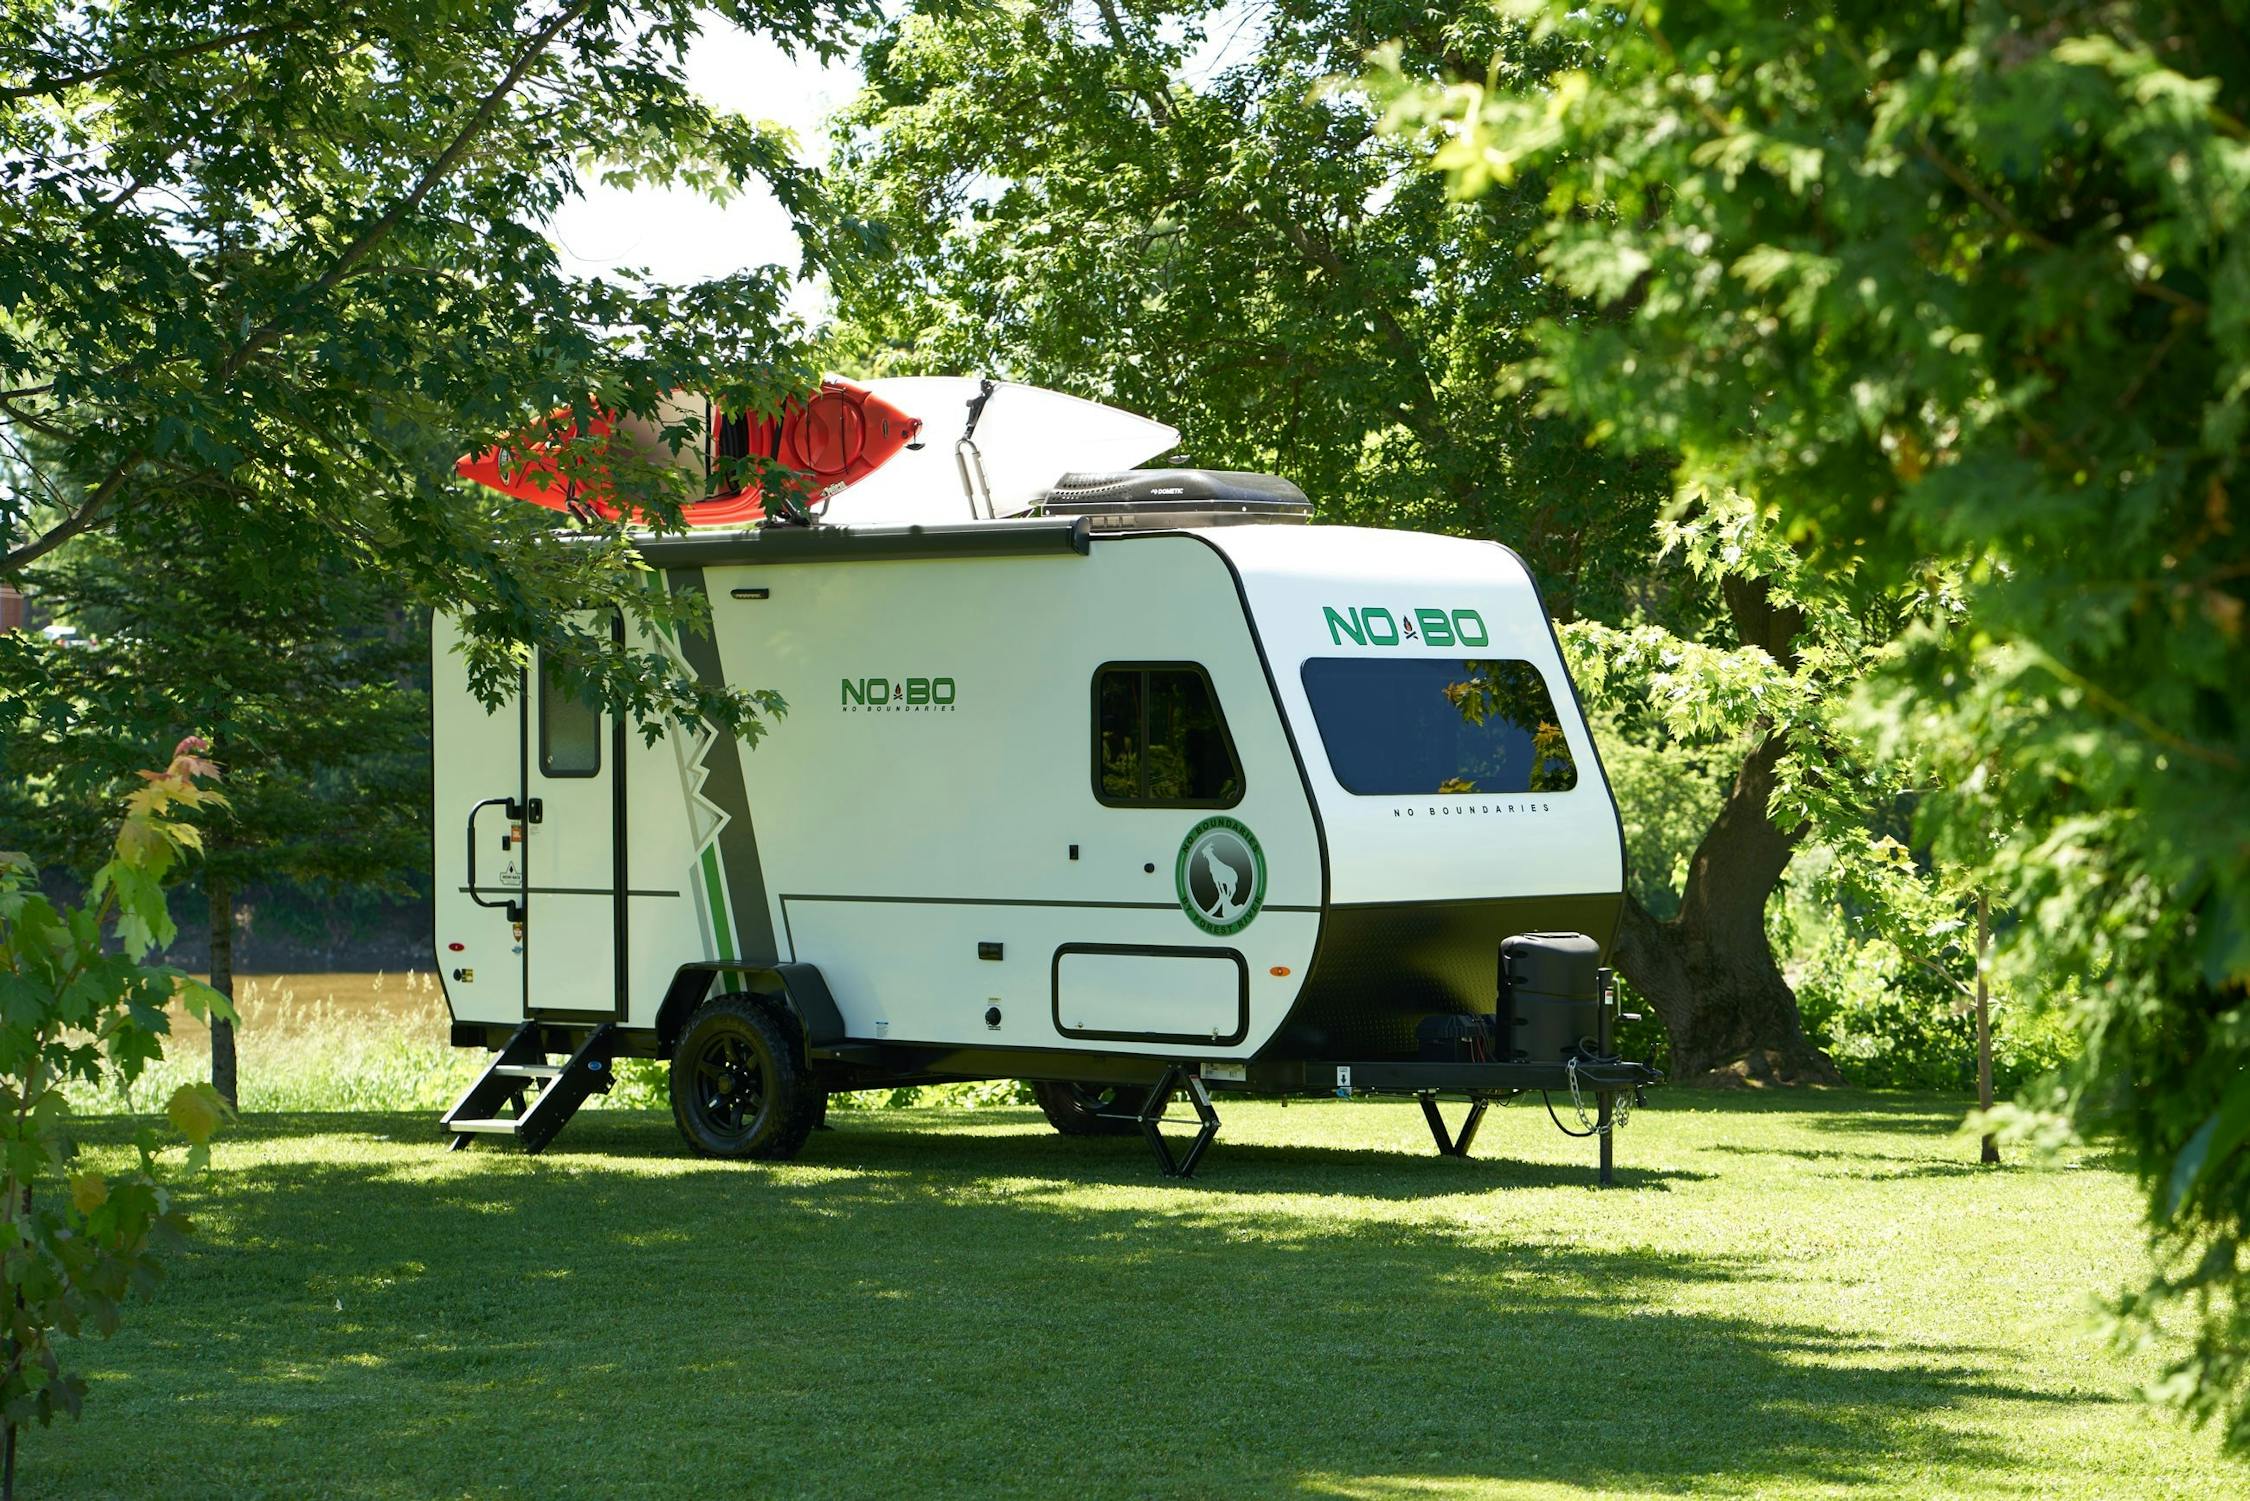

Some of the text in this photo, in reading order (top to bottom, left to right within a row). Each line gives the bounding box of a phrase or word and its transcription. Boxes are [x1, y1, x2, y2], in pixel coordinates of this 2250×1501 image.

[1157, 487, 1184, 495] DOMETIC
[1393, 803, 1550, 817] NO BOUNDARIES
[1182, 818, 1259, 854] NO BOUNDARIES
[1193, 914, 1233, 934] FOREST
[1238, 896, 1262, 929] RIVER
